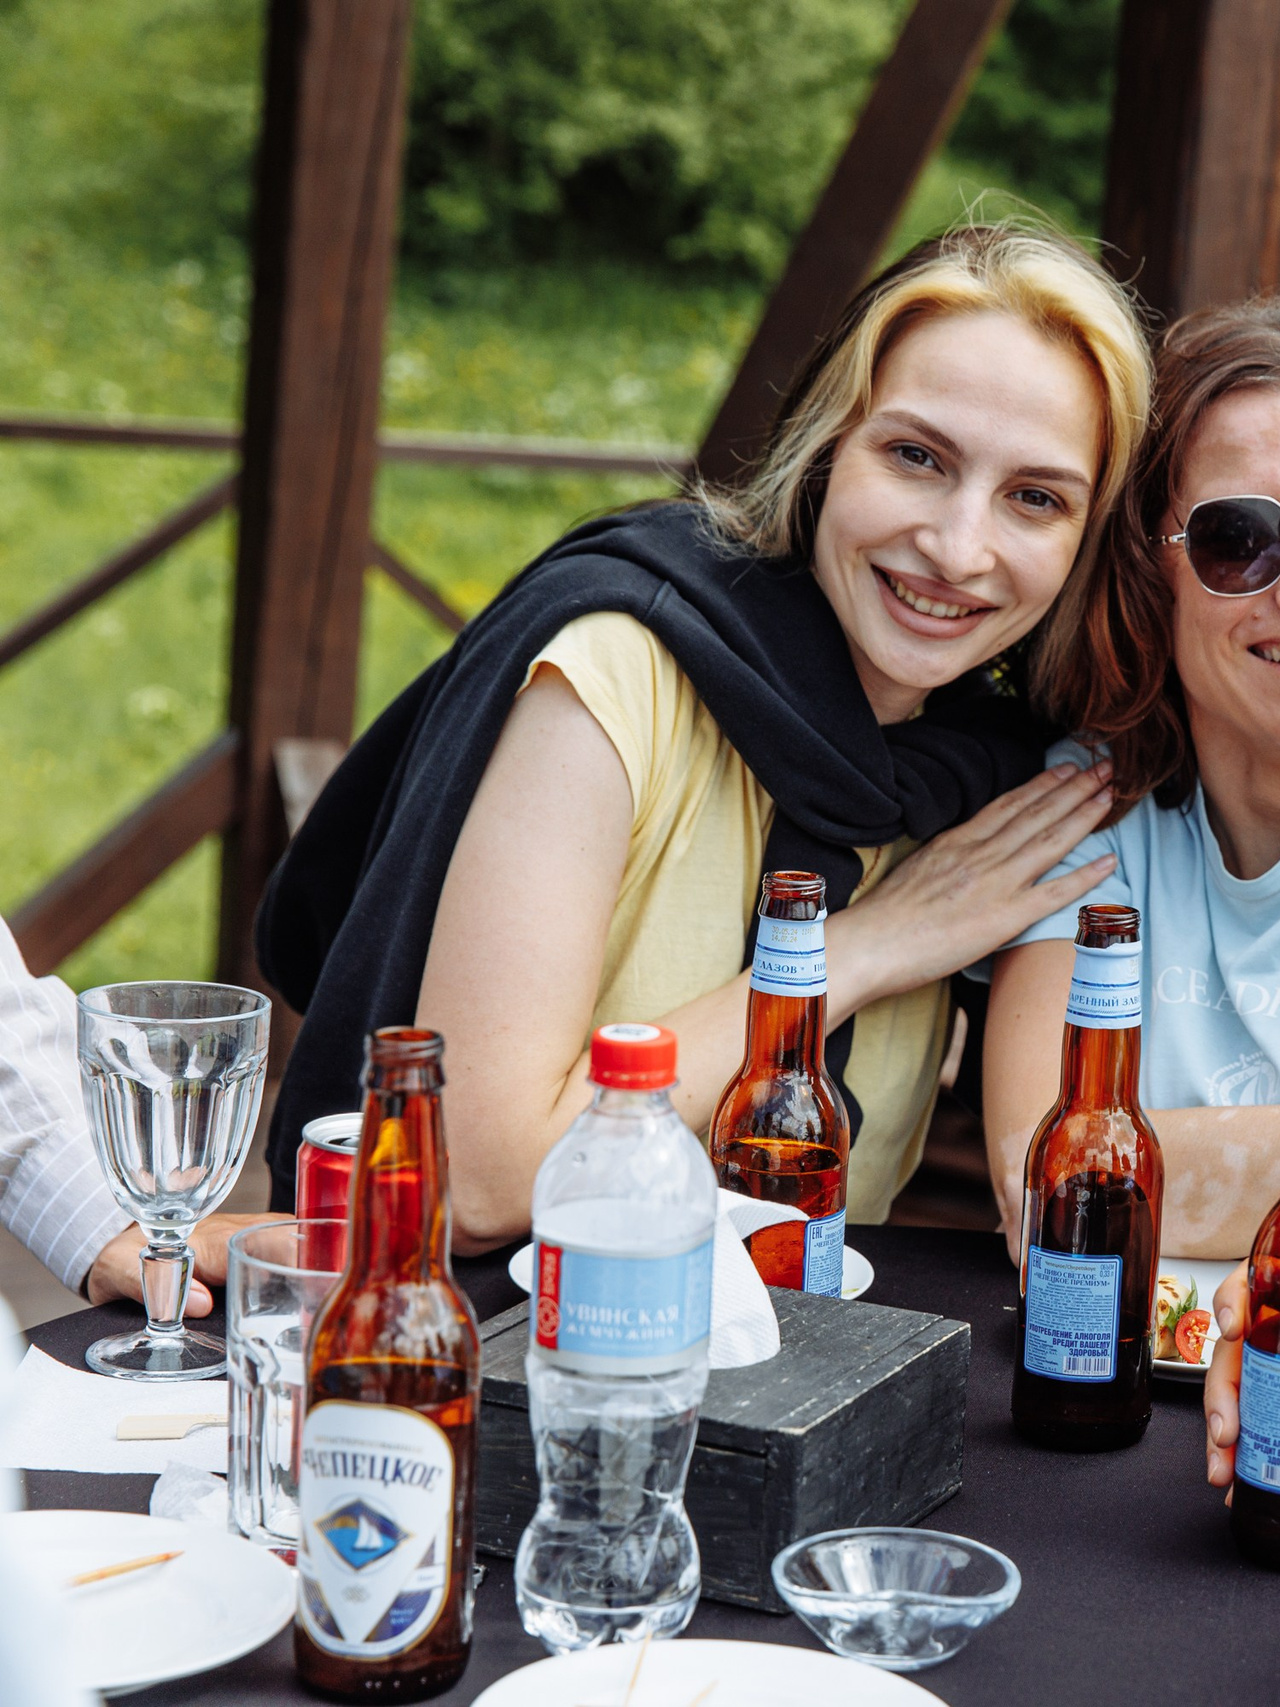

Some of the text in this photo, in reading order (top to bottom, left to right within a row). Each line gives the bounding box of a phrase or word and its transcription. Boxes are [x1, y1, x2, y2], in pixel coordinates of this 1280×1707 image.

[1069, 992, 1119, 1007] АРЕННЫЙ
[1044, 1268, 1097, 1280] ПИВО СВЕТЛОЕ
[565, 1302, 679, 1325] УВИНСКАЯ
[1029, 1322, 1111, 1341] УПОТРЕБЛЕНИЕ АЛКОГОЛЯ
[1052, 1338, 1110, 1349] ВРЕДИТ ВАШЕМУ
[1069, 1348, 1110, 1357] ЗДОРОВЬЮ.
[302, 1447, 443, 1492] ЧЕПЕЦКОЕ
